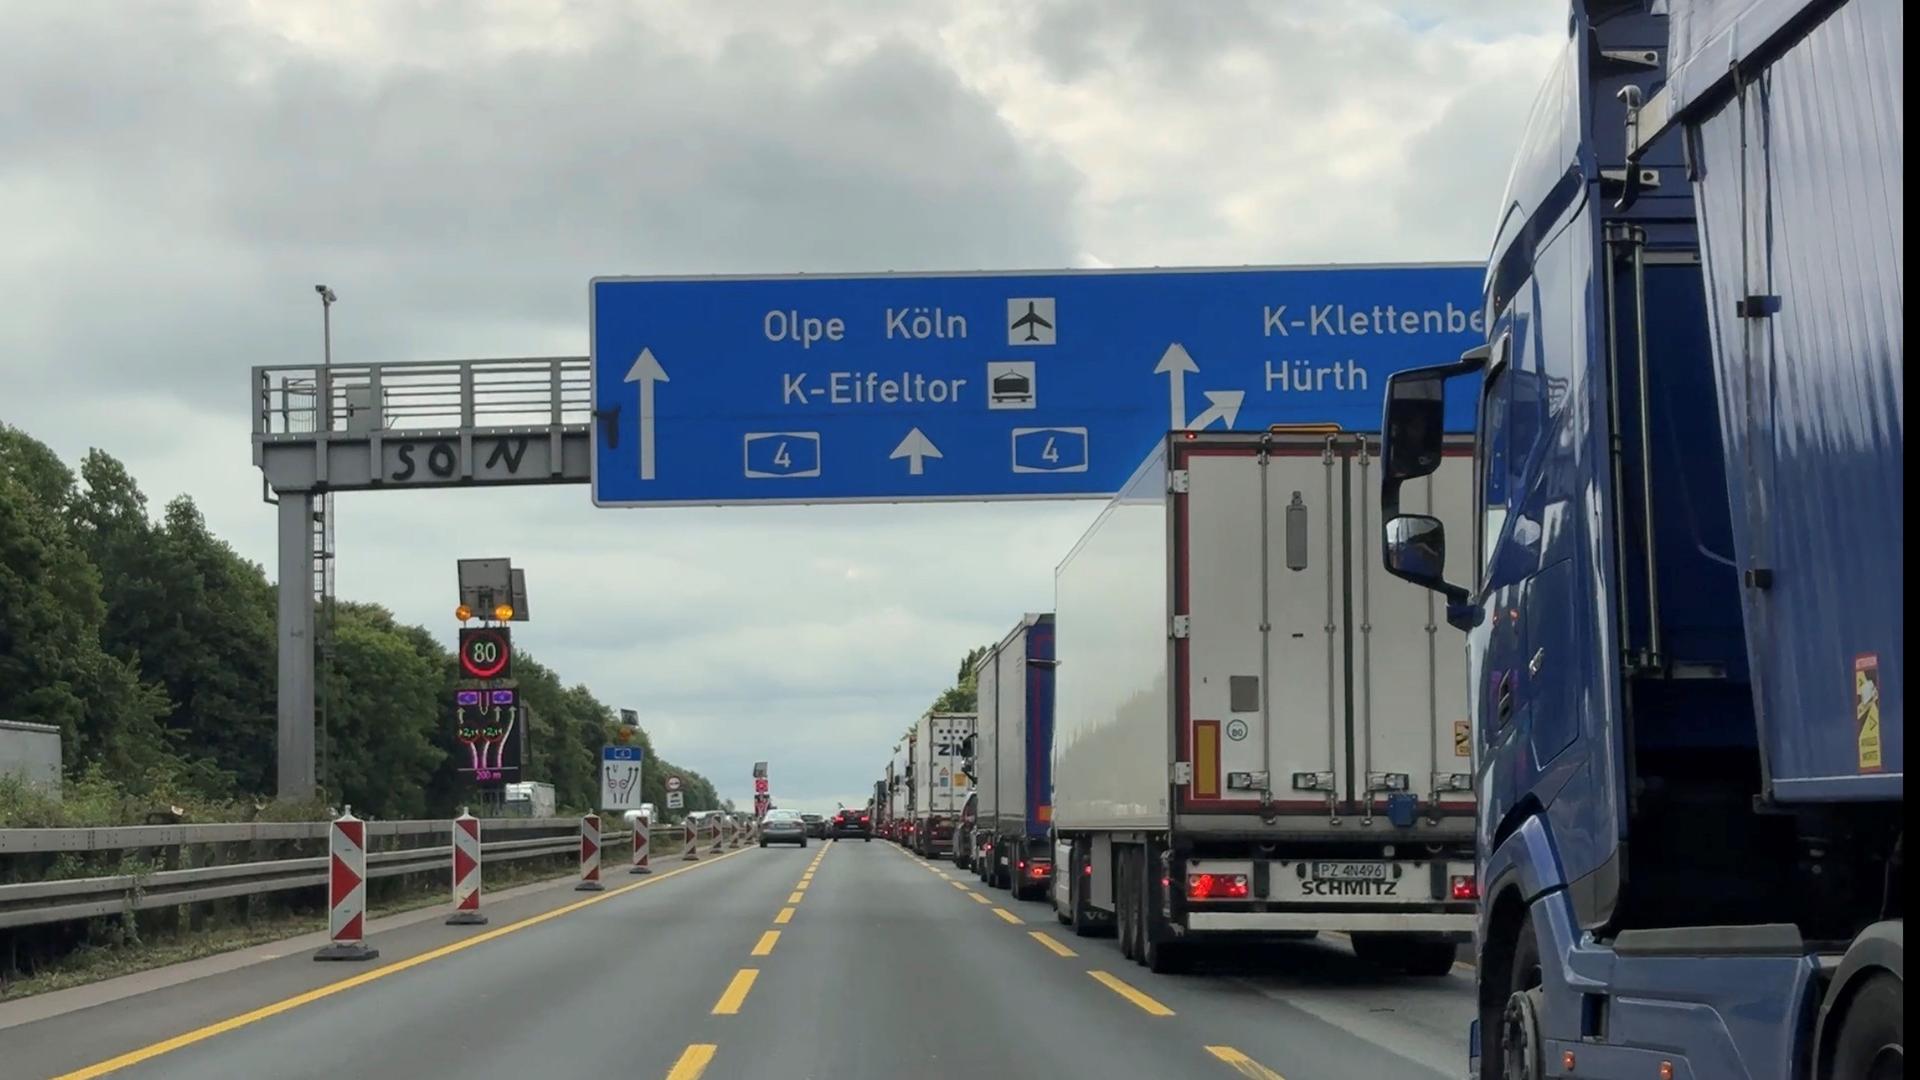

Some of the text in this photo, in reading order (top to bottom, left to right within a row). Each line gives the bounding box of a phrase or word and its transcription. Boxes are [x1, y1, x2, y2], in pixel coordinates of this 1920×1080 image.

[764, 308, 967, 348] Olpe Köln
[783, 372, 967, 404] K-Eifeltor
[1265, 359, 1368, 391] Hürth
[773, 442, 792, 468] 4
[1041, 436, 1060, 463] 4
[474, 642, 496, 663] 80
[1321, 864, 1382, 877] PZ 4N496
[1302, 880, 1398, 895] SCHMITZ
